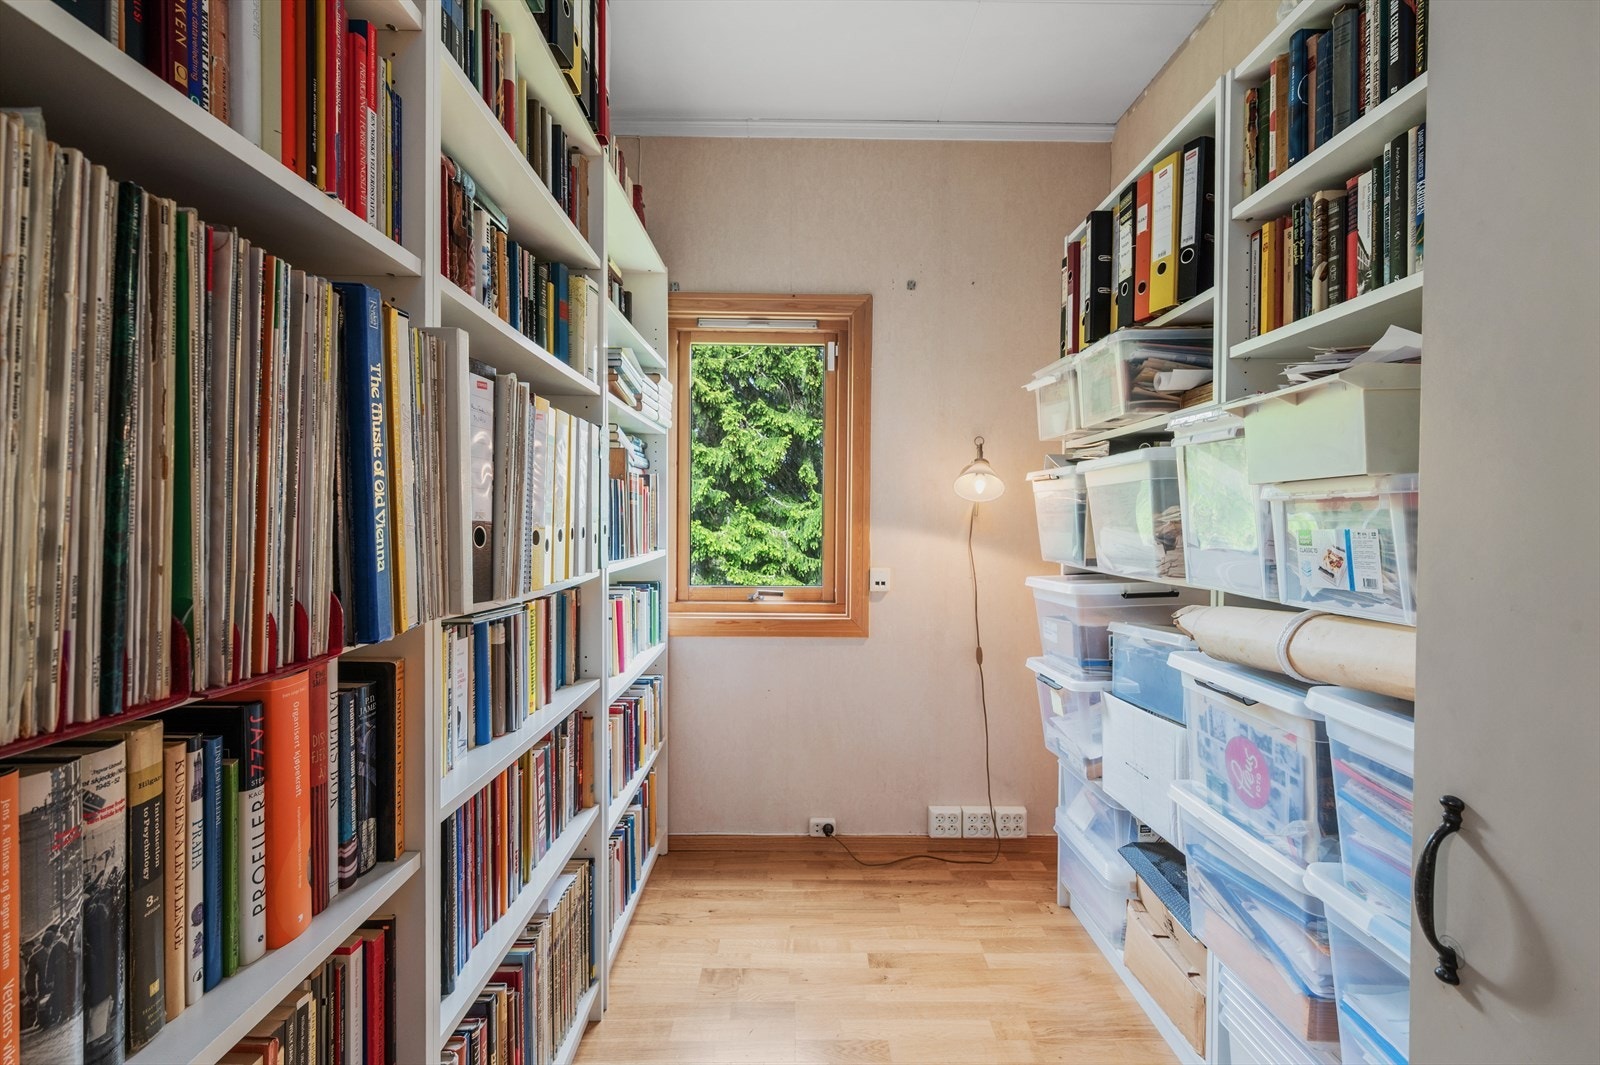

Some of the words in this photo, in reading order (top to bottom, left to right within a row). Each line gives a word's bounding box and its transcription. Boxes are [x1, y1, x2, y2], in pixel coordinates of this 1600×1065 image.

[359, 62, 367, 112] FREMGANG
[369, 112, 377, 127] DEN
[369, 127, 377, 156] NORSKE
[369, 157, 377, 219] VELFERDSSTATEN
[370, 362, 381, 399] The
[371, 402, 383, 457] Music
[373, 459, 384, 477] of
[374, 479, 385, 508] Old
[375, 509, 386, 573] Vienna
[249, 715, 265, 778] JAZZ
[292, 700, 301, 748] Organisert
[329, 690, 338, 763] BAUERS
[174, 760, 186, 836] KUNSTEN
[292, 750, 303, 798] kjøpekraft
[329, 771, 338, 809] BOK
[1254, 772, 1263, 799] FOTO
[0, 799, 9, 822] Jens
[143, 807, 151, 817] to
[538, 768, 546, 840] LENIN
[1, 824, 10, 835] A.
[142, 818, 151, 881] Psychology
[154, 801, 162, 868] Introduction
[191, 819, 204, 871] PRAHA
[2, 837, 11, 876] Riisnæs
[174, 853, 185, 894] LEVE
[251, 798, 266, 917] PROFILER
[0, 879, 9, 893] og
[1, 895, 12, 930] Ragnar
[174, 896, 185, 952] LENGE
[2, 932, 12, 969] Hatlem
[3, 977, 15, 1037] Verdens
